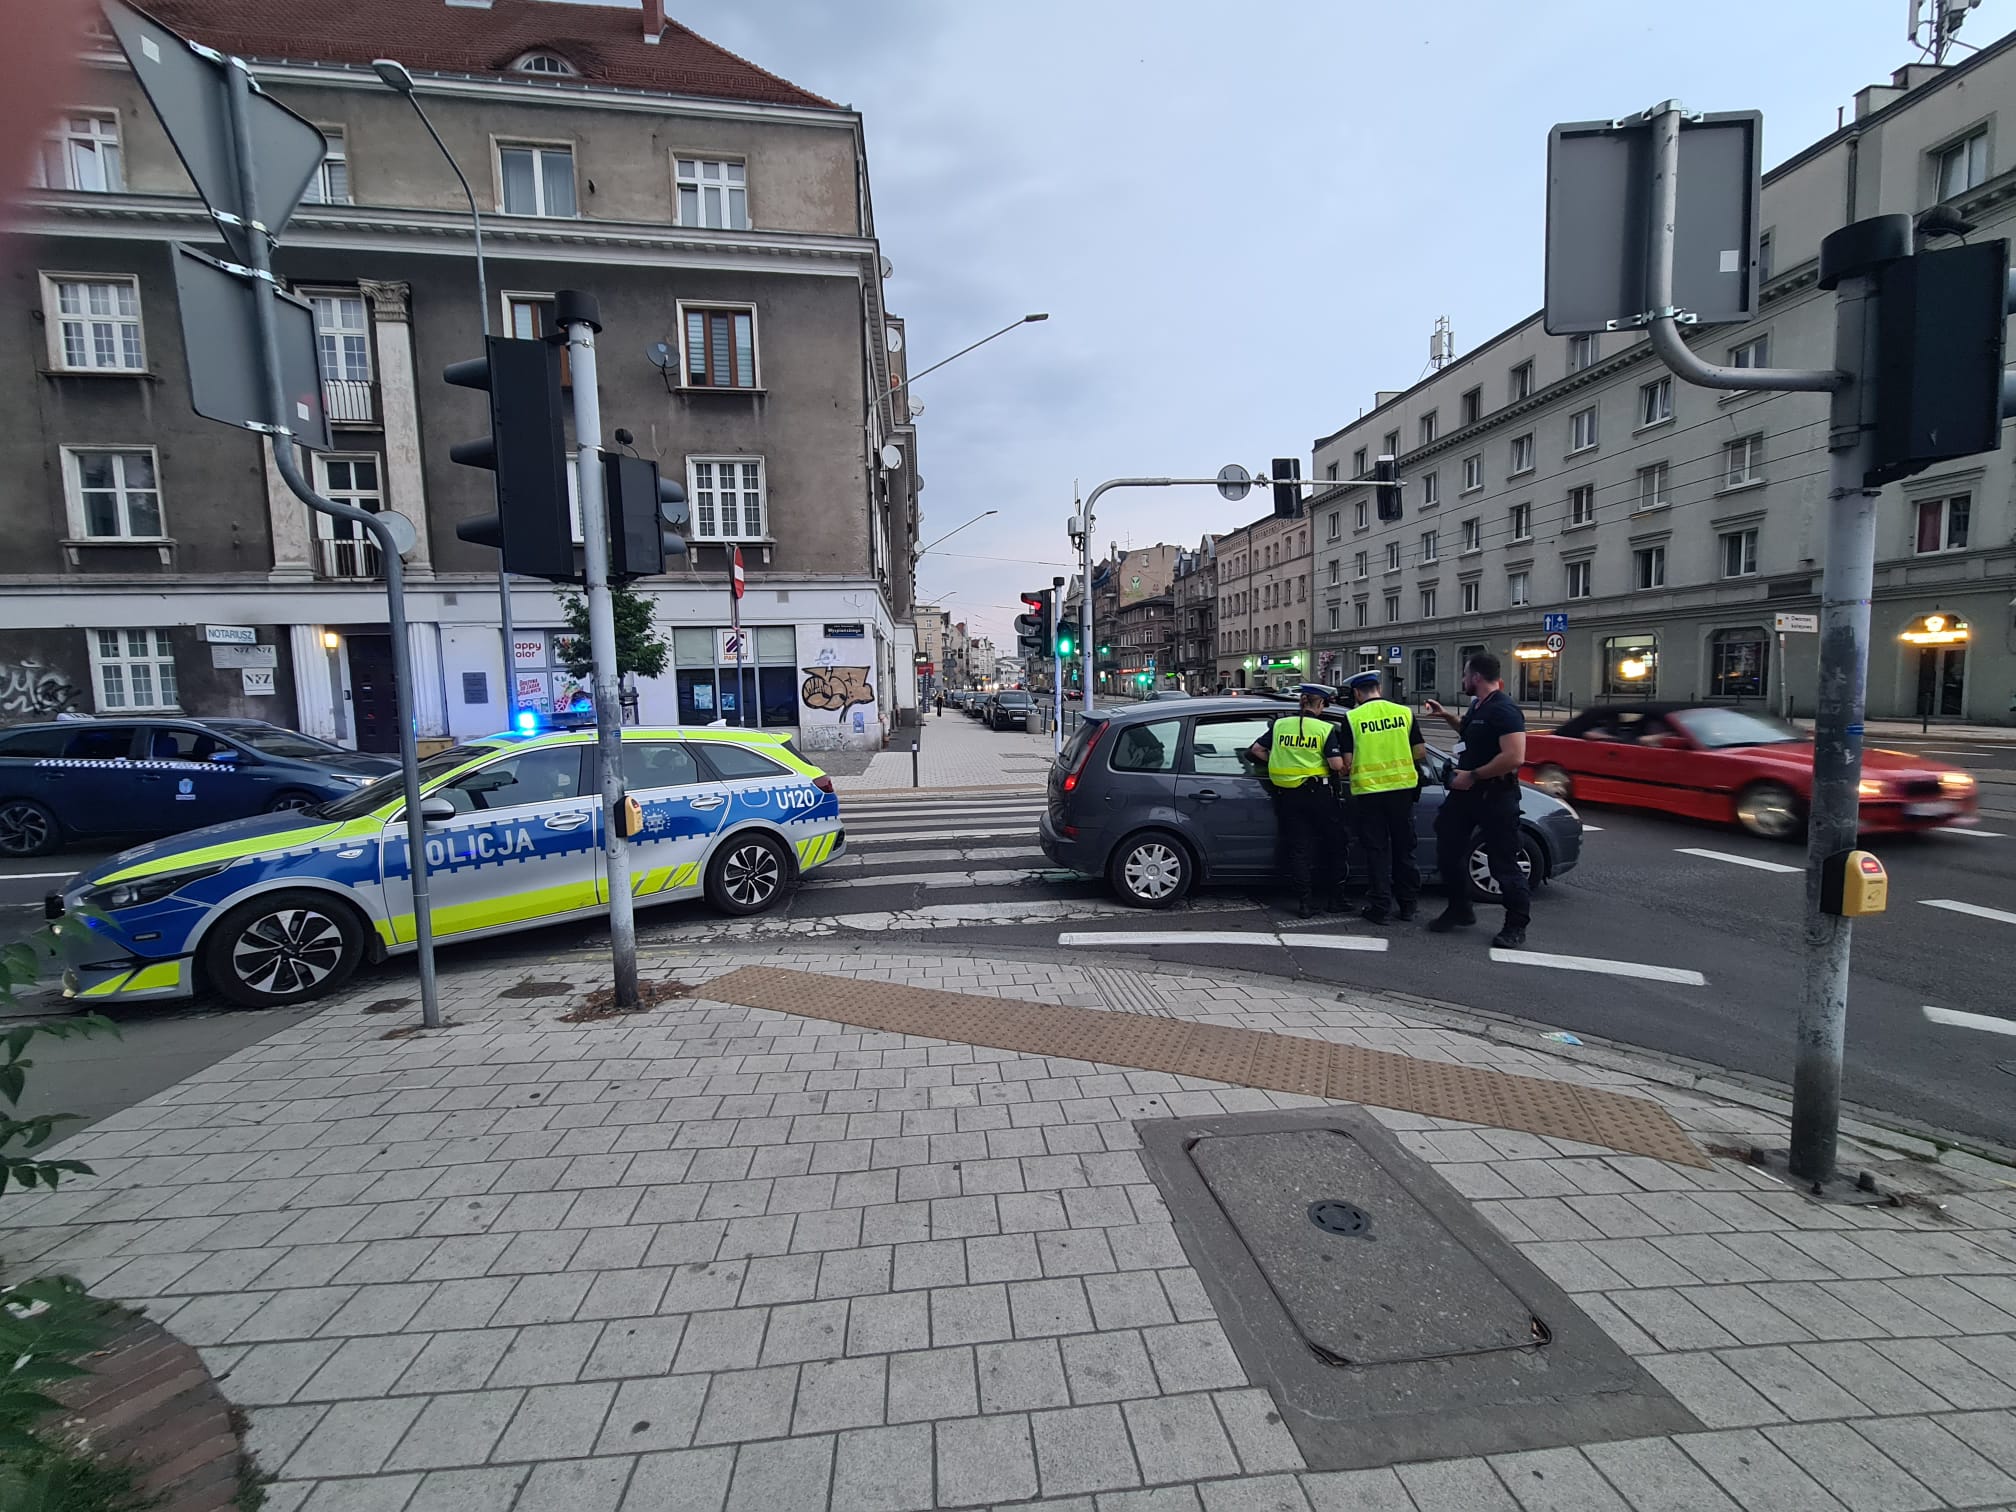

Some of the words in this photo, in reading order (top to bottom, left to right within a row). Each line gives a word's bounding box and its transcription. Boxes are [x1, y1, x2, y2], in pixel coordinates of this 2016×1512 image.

[208, 629, 253, 640] NOTARIUSZ
[515, 642, 542, 651] appy
[1549, 638, 1562, 648] 40
[1391, 647, 1400, 657] P
[245, 674, 273, 684] NFZ
[1361, 716, 1406, 734] POLICJA
[1279, 735, 1317, 748] POLICJA
[776, 789, 815, 809] U120
